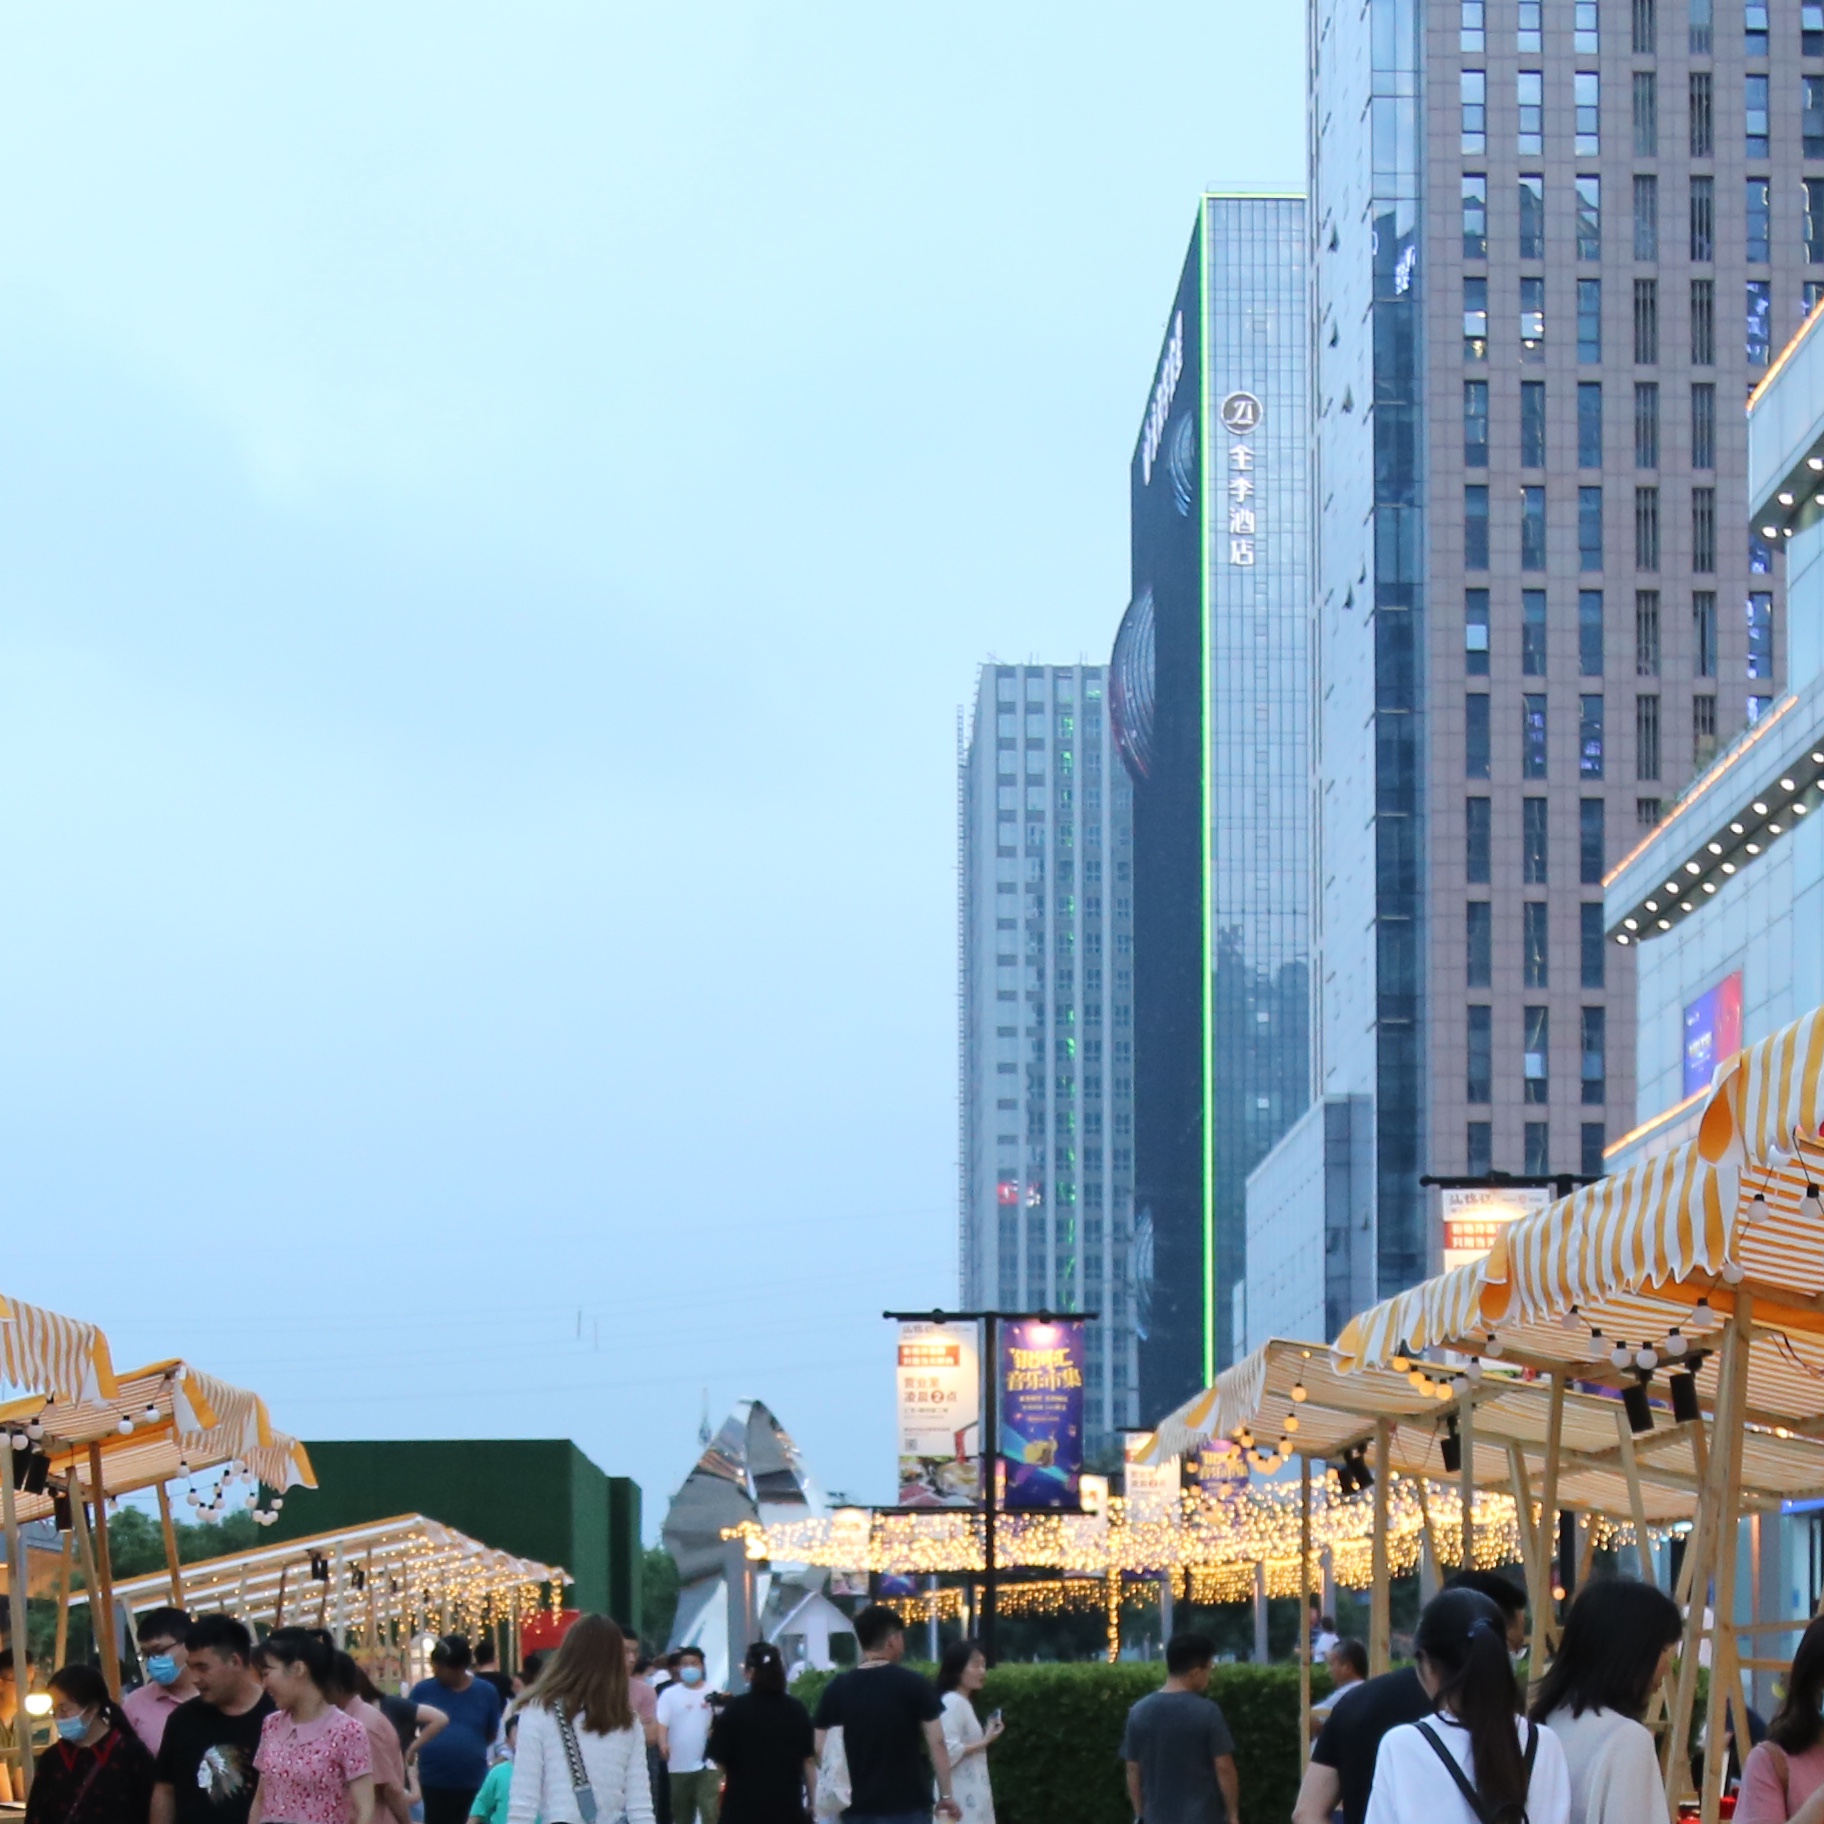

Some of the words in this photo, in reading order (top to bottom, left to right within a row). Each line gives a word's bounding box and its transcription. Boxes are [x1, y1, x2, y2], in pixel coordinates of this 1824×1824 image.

[1229, 444, 1256, 567] 全季酒店
[1006, 1367, 1083, 1392] 音乐市集
